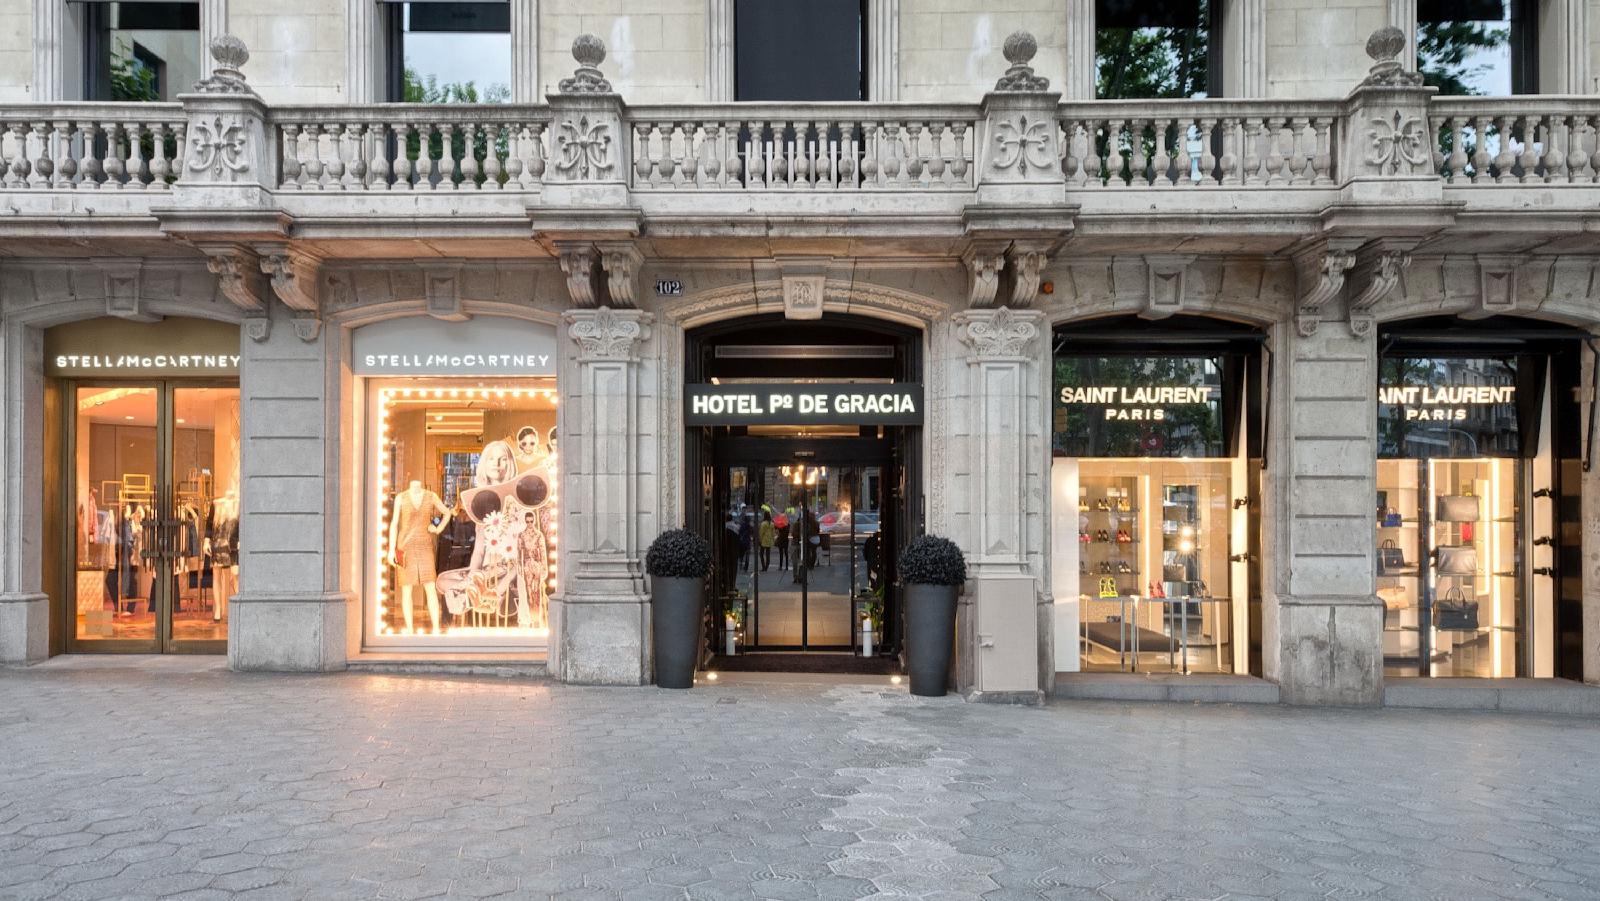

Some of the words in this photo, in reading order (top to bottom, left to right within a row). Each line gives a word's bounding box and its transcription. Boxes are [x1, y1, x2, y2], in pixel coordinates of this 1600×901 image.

[659, 281, 680, 294] 102
[1061, 387, 1117, 403] SAINT
[1121, 387, 1211, 403] LAURENT
[1379, 387, 1419, 403] AINT
[1422, 387, 1515, 403] LAURENT
[693, 395, 763, 414] HOTEL
[799, 395, 828, 413] DE
[834, 394, 915, 413] GRACIA
[1106, 409, 1164, 420] PARIS
[1406, 409, 1466, 420] PARIS
